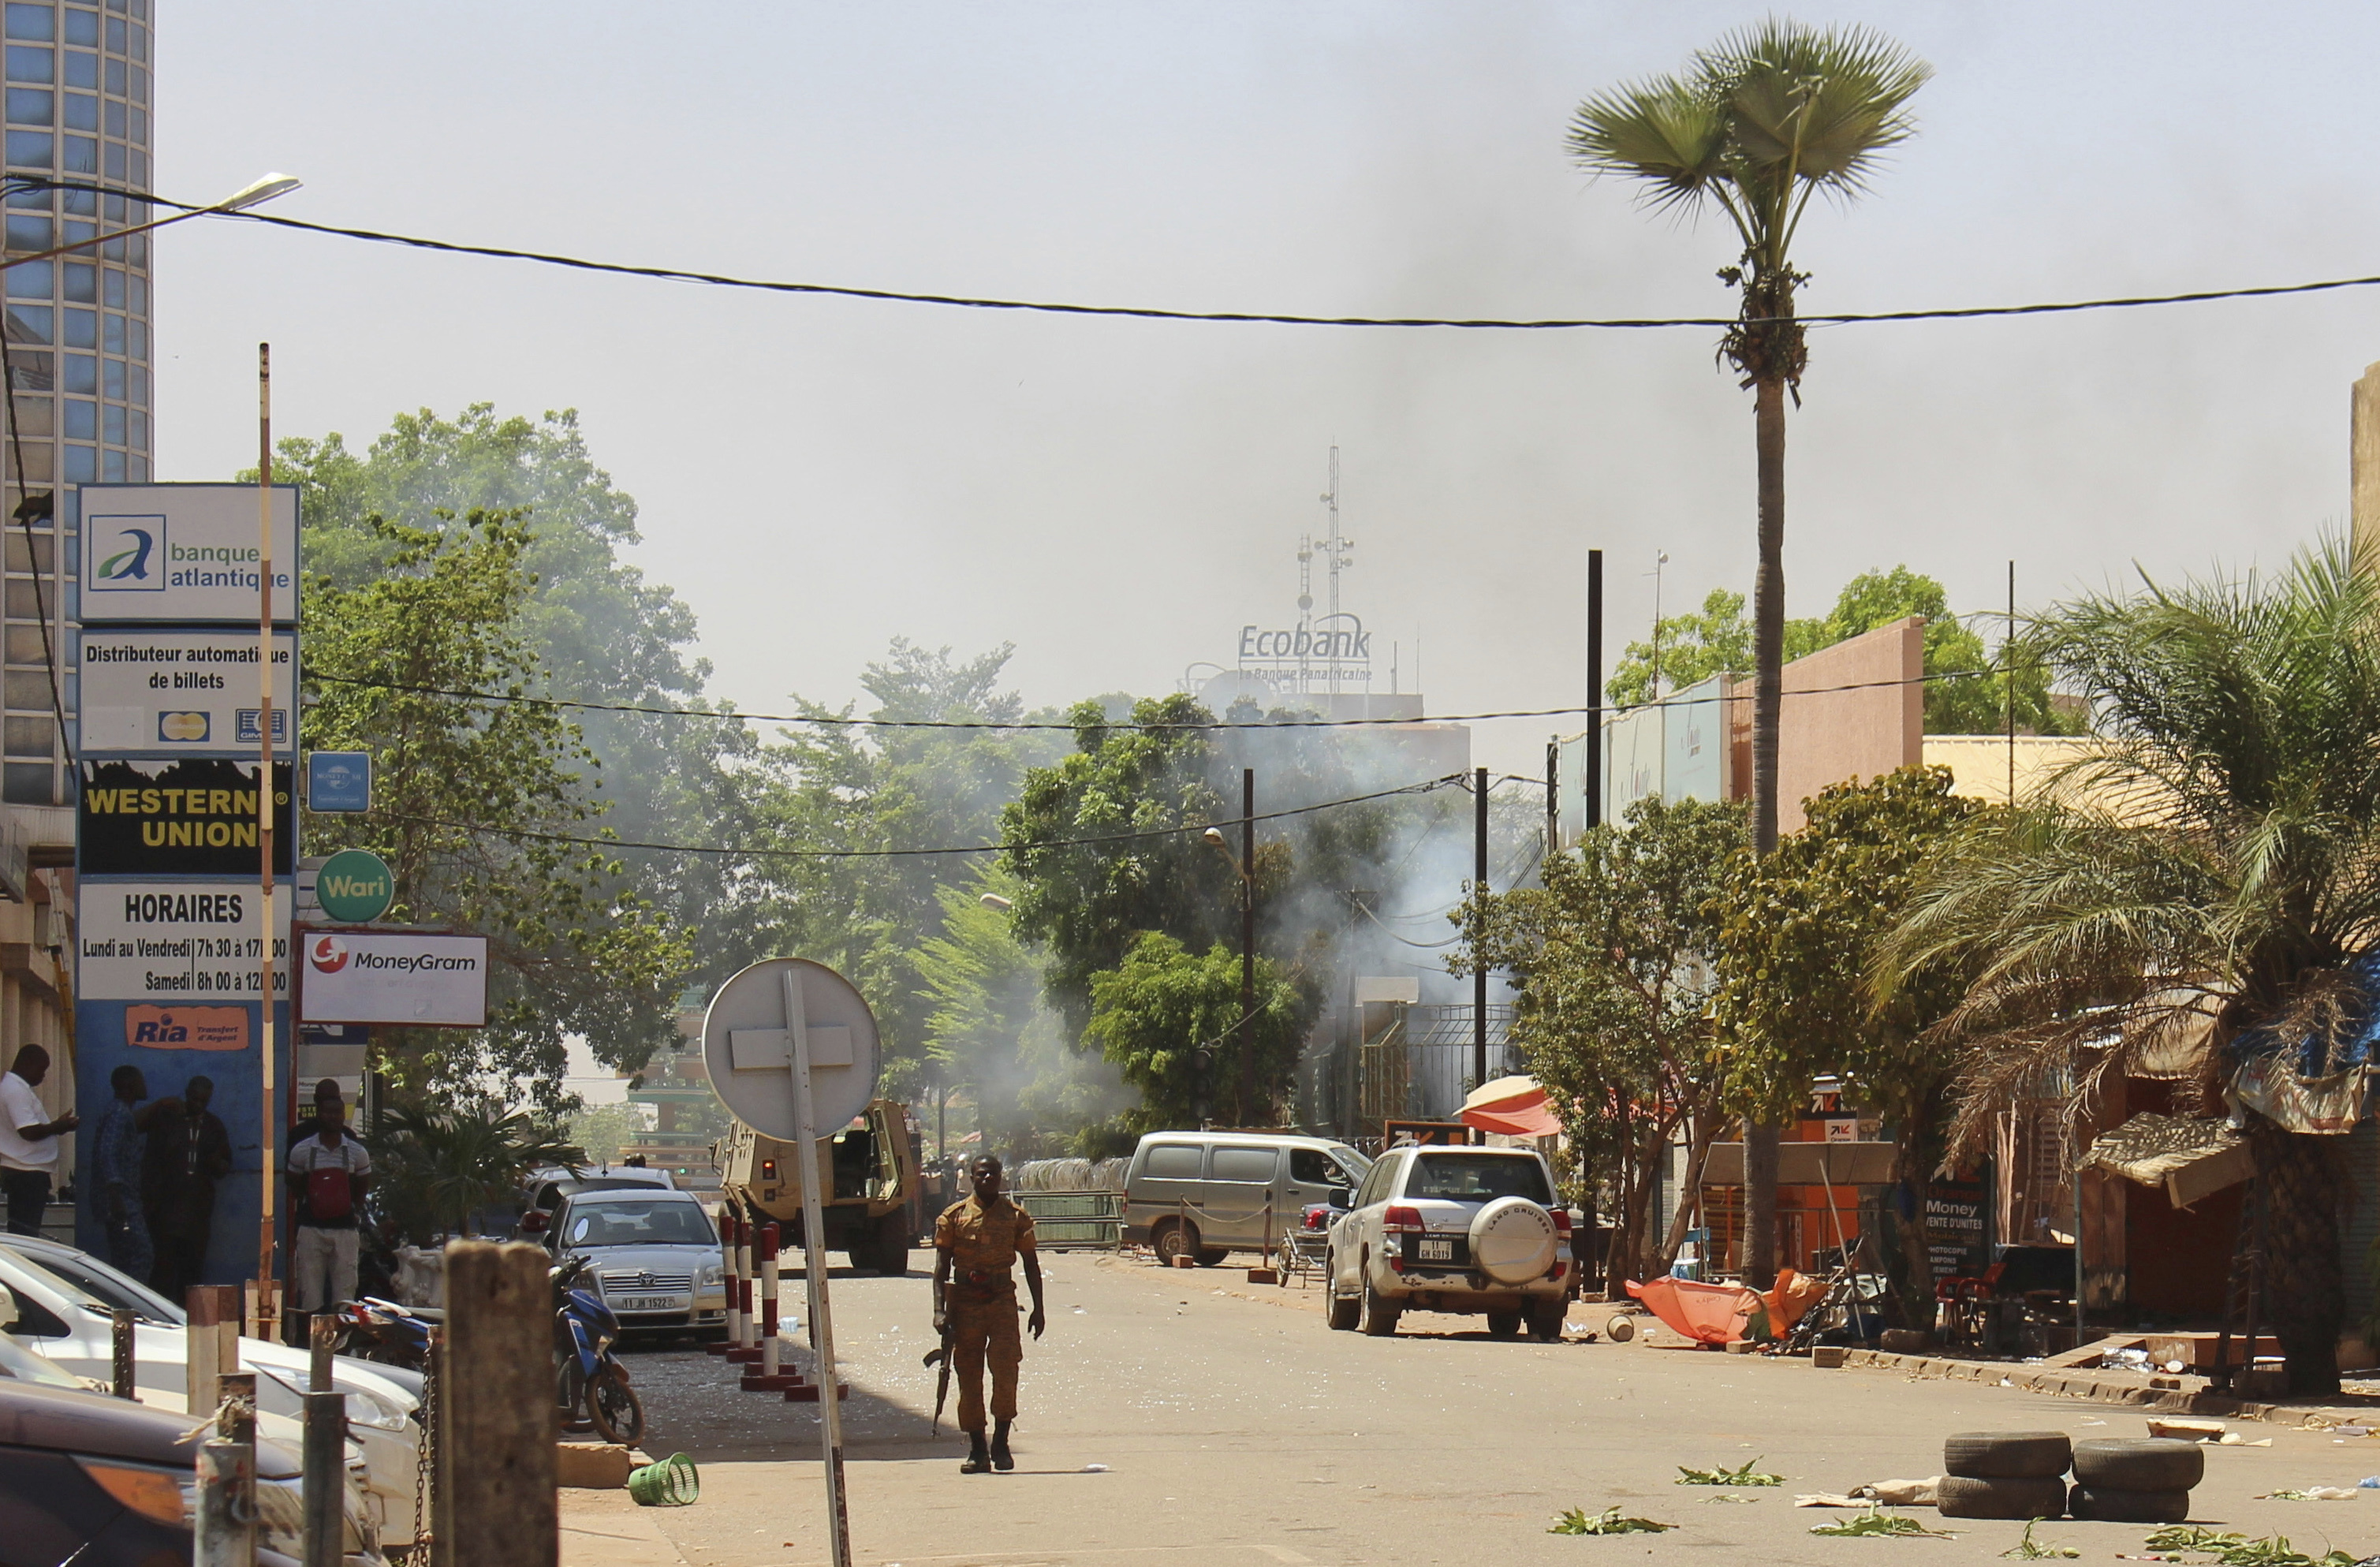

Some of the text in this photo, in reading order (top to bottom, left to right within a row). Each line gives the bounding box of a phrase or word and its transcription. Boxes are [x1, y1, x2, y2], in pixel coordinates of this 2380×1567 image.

[171, 543, 260, 565] banque
[1239, 617, 1372, 658] Ecobank
[86, 645, 289, 663] Distributeur automatiue
[149, 672, 225, 689] de billets
[1301, 667, 1372, 681] Panafricaine
[87, 789, 256, 815] WESTERN
[142, 821, 256, 848] UNION
[324, 875, 385, 898] Wari
[125, 894, 243, 923] HORAIRES
[83, 938, 116, 957] Lundi
[119, 943, 133, 957] au
[137, 938, 190, 958] Vendredi
[197, 938, 213, 958] 7h
[216, 938, 231, 958] 30
[234, 938, 242, 958] à
[272, 938, 286, 958] 00
[355, 952, 476, 974] MoneyGram
[145, 972, 190, 991] Samedi
[197, 972, 212, 991] 8h
[216, 972, 231, 991] 00
[234, 972, 242, 991] à
[272, 972, 286, 991] 00
[135, 1013, 238, 1043] Ria Transfert
[197, 1034, 237, 1043] d'Argent
[1926, 1200, 1978, 1218] Money
[1488, 1207, 1550, 1235] LAND CRUISER
[1949, 1218, 1983, 1230] D'UNITES
[1432, 1241, 1439, 1250] 11
[1929, 1255, 1957, 1264] AMPONS
[625, 1299, 632, 1308] 11
[648, 1297, 667, 1308] 1522
